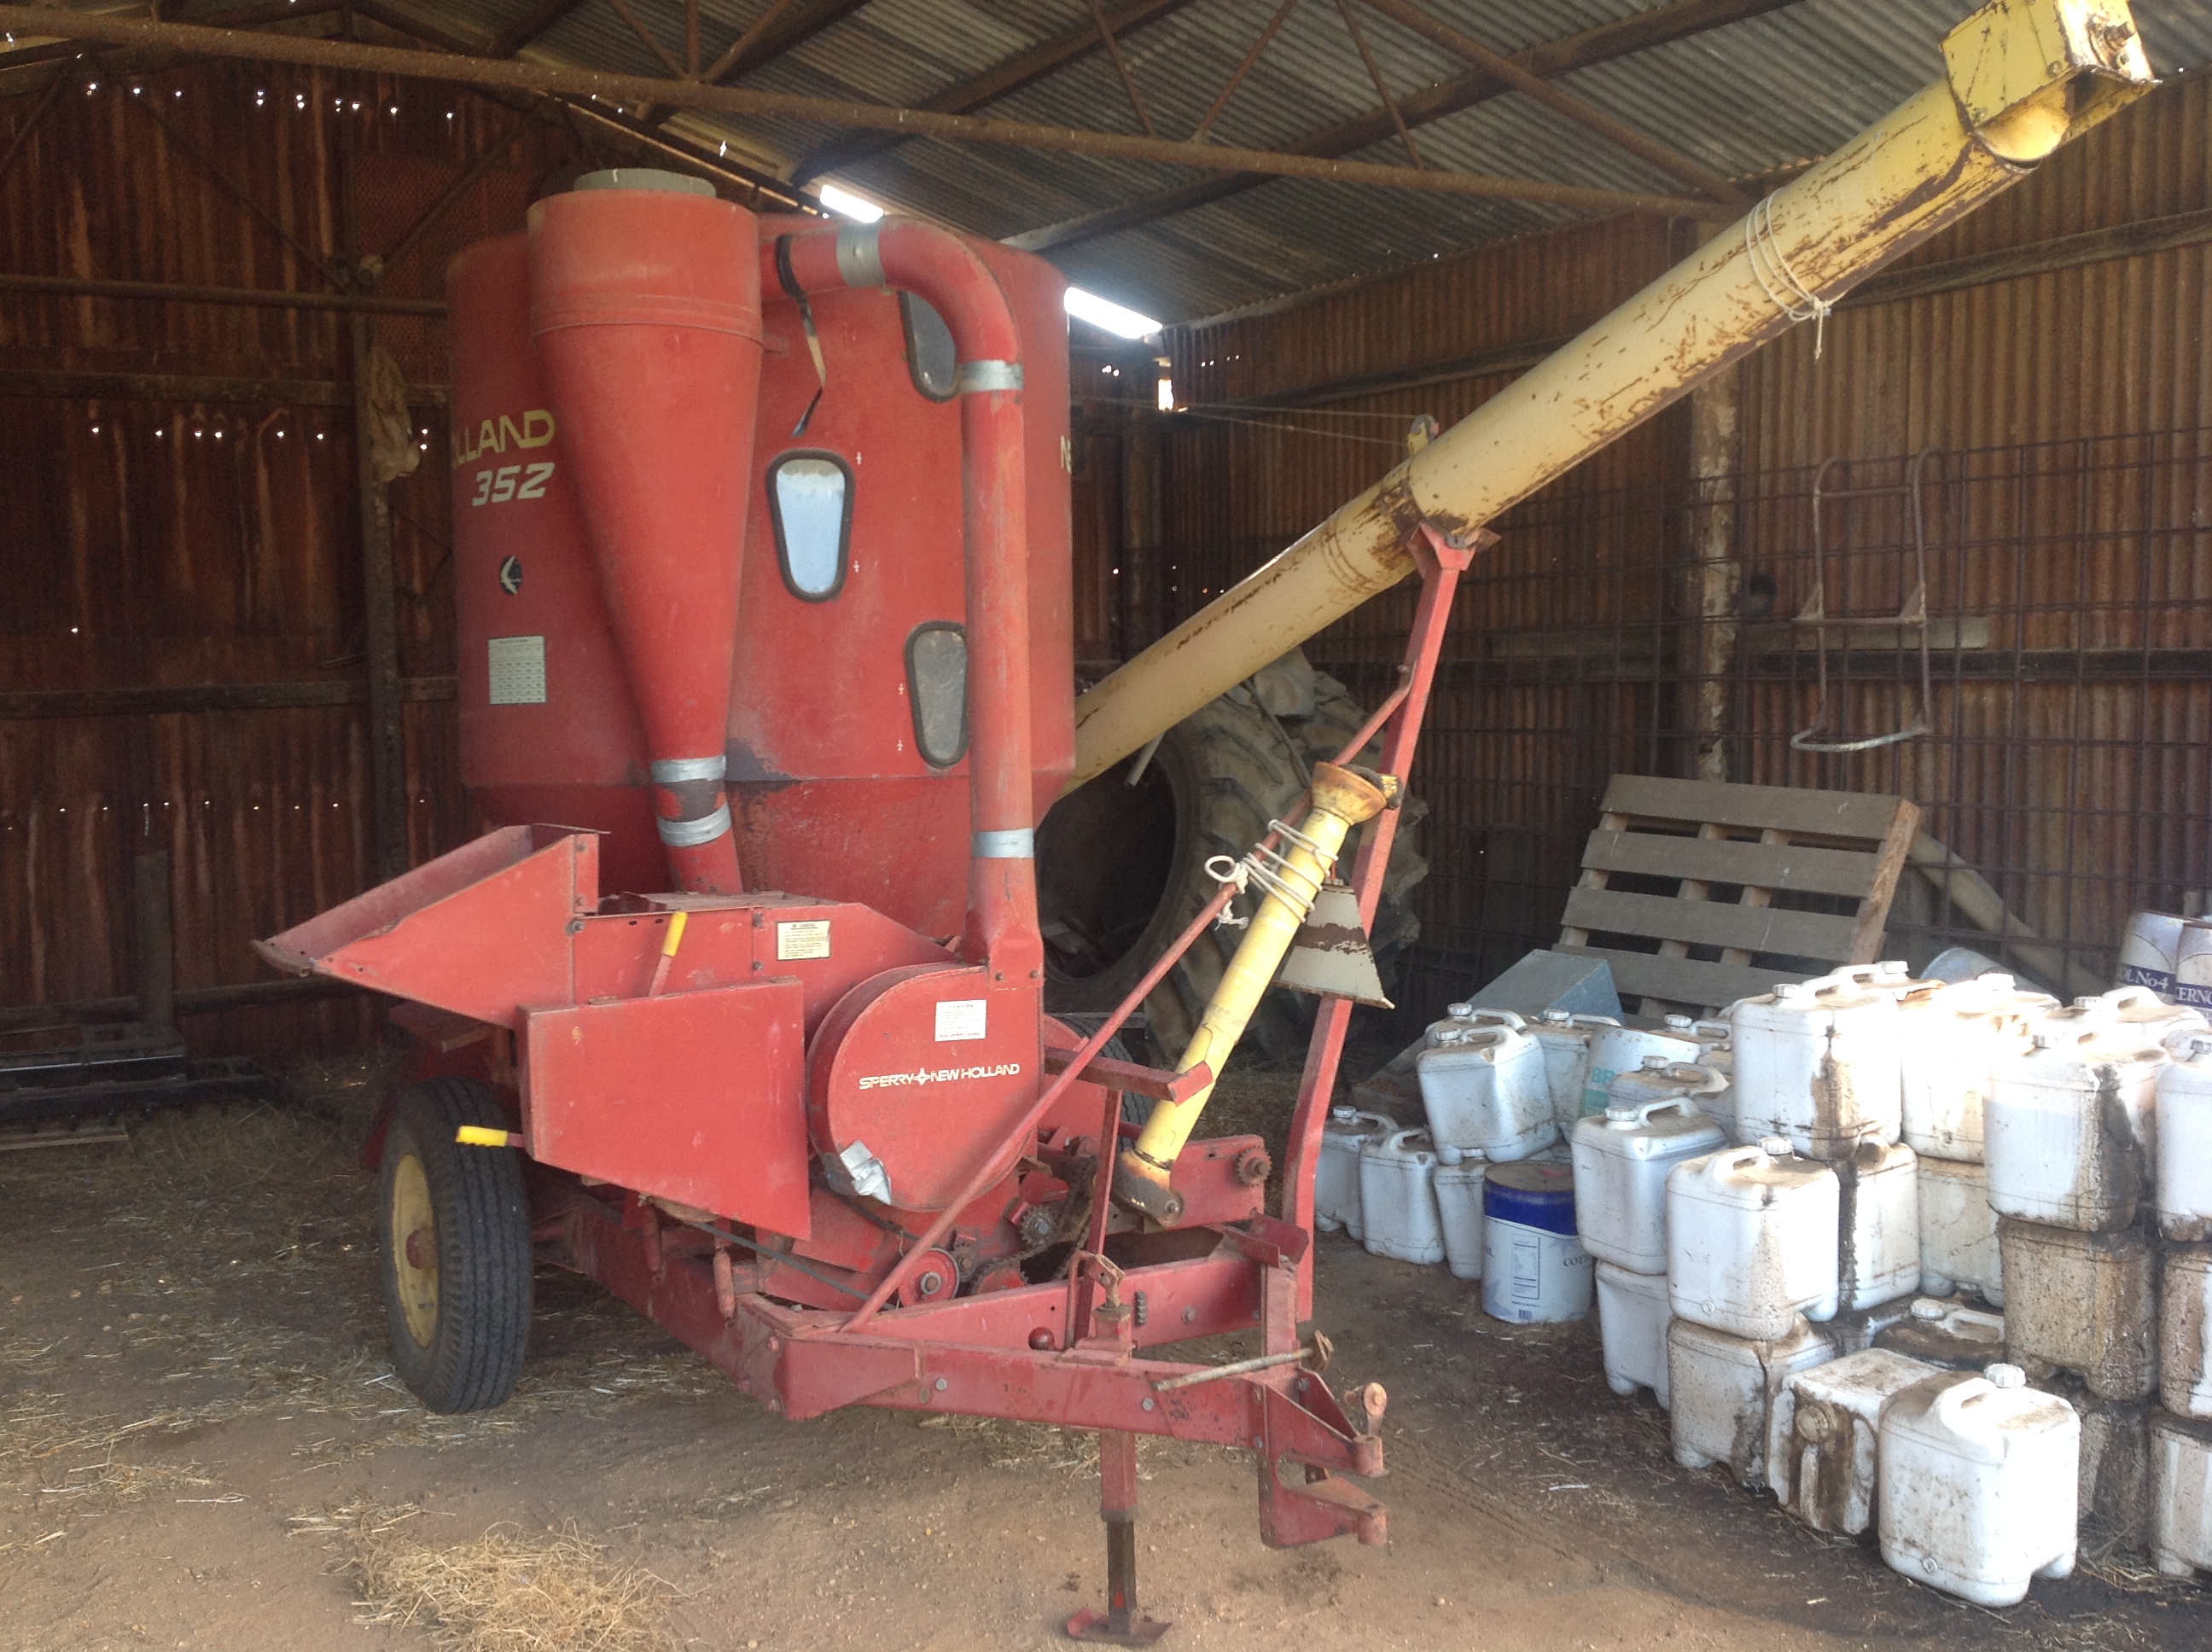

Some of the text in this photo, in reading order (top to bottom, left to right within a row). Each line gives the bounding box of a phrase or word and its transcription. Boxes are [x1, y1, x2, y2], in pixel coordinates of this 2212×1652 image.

[472, 462, 555, 507] 352
[859, 1063, 1020, 1090] SPERRY NEW HOLLAND
